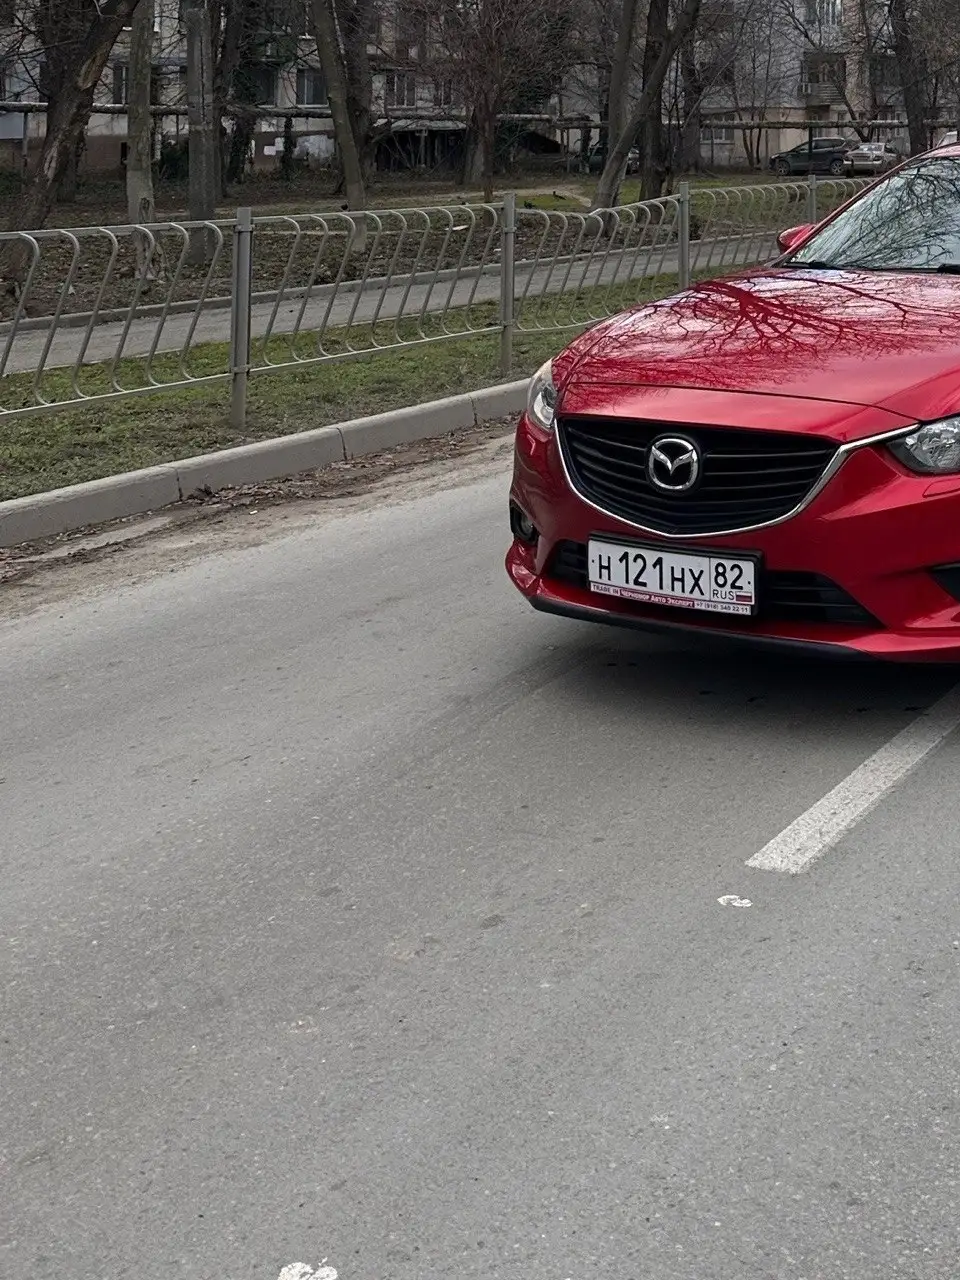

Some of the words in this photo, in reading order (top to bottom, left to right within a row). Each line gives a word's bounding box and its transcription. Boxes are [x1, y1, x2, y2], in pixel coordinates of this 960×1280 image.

[714, 562, 743, 590] 82
[592, 584, 611, 594] TRADE
[712, 589, 734, 601] RUS
